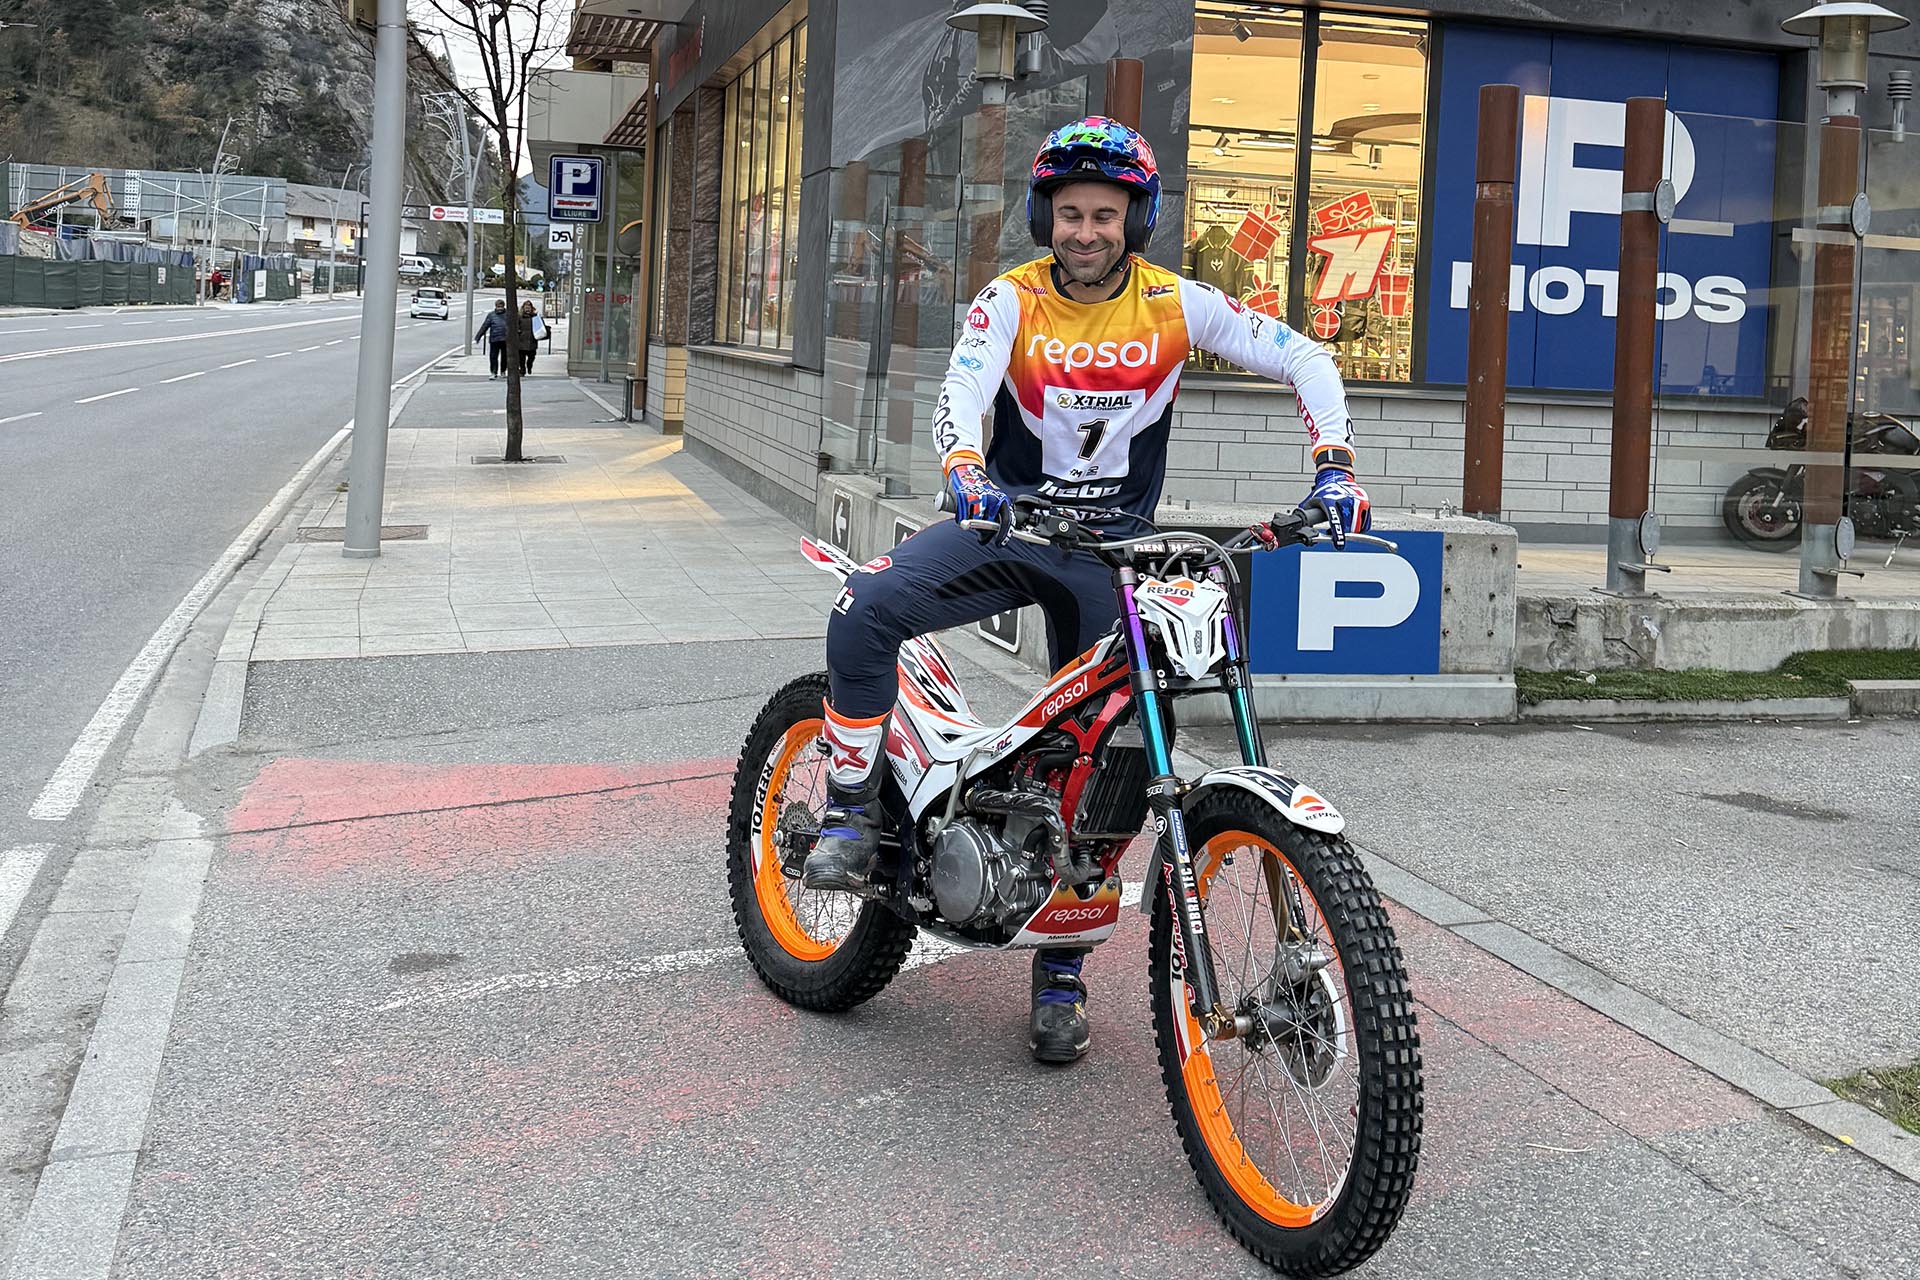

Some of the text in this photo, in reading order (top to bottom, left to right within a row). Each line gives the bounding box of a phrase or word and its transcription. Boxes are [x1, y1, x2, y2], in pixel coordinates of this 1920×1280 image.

[562, 162, 592, 195] P
[1026, 332, 1159, 373] repsol
[1077, 418, 1109, 461] 1
[1147, 585, 1195, 599] REPSOL
[1297, 551, 1420, 651] P
[1041, 675, 1088, 721] repsol
[891, 758, 908, 786] HONDA
[751, 762, 774, 836] REPSOL
[1173, 811, 1187, 853] MICHELIN
[1045, 904, 1110, 924] repsol
[1047, 933, 1081, 941] Montesa
